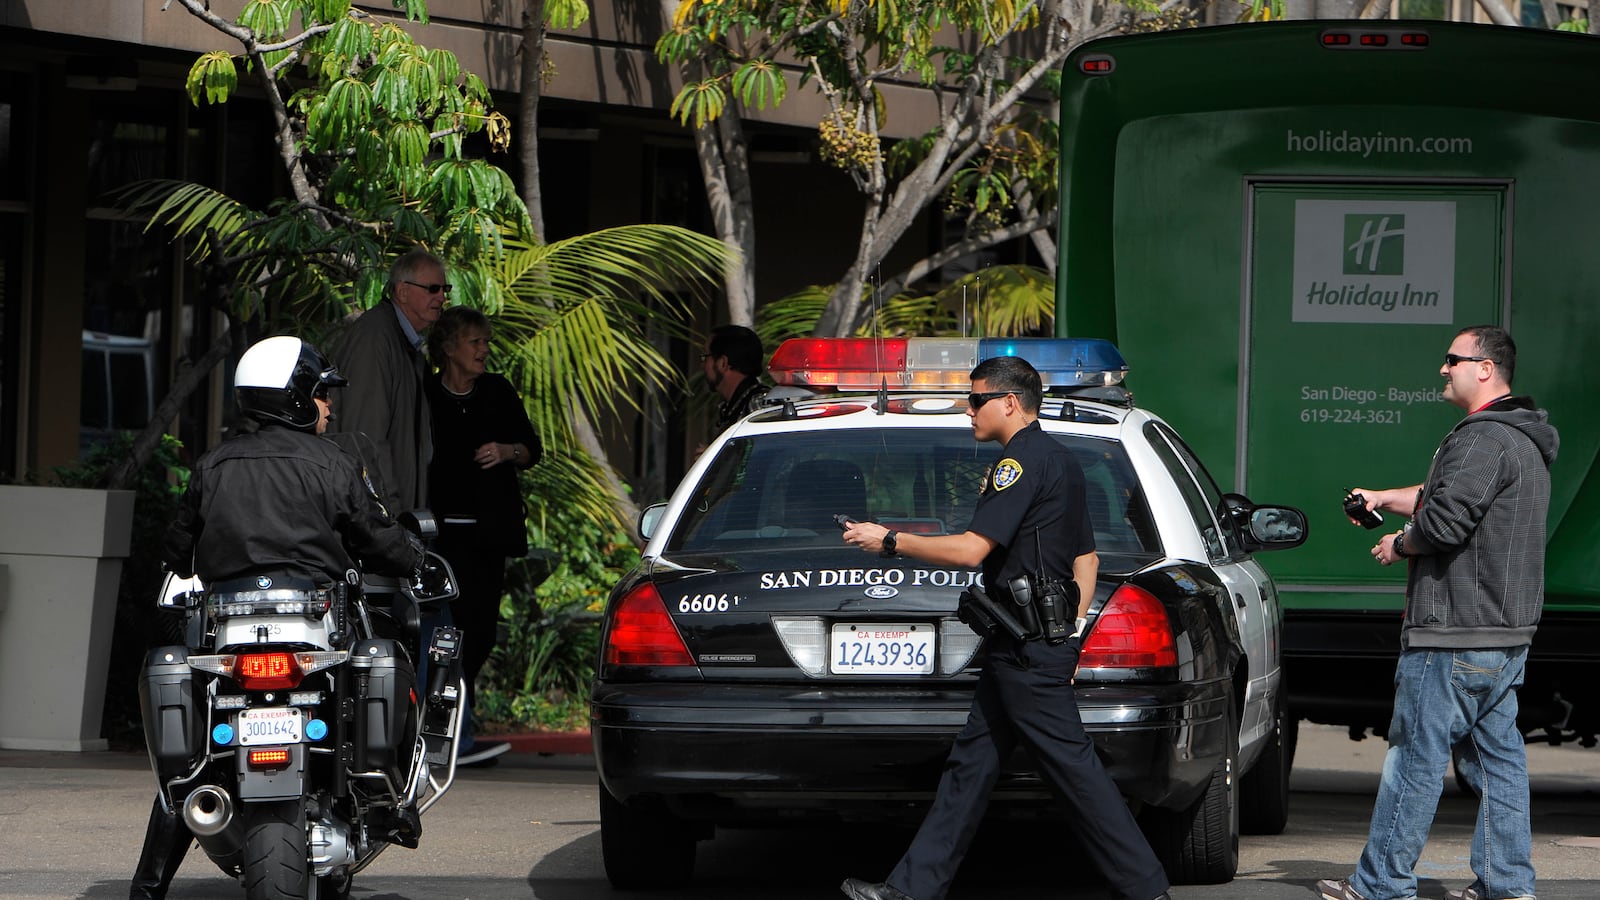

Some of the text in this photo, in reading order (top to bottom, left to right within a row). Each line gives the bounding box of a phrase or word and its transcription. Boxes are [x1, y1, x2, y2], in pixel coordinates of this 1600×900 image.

[1287, 129, 1473, 158] holidayinn.com
[1306, 281, 1440, 312] Holiday Inn
[1301, 386, 1329, 401] San
[1332, 386, 1377, 404] Diego
[1388, 387, 1445, 405] Bayside
[1300, 409, 1402, 424] 619-224-3621
[760, 568, 985, 589] SAN DIEGO POLIC
[678, 594, 729, 613] 6606
[250, 623, 282, 636] 425
[857, 631, 910, 639] CA EXEMPT
[838, 641, 928, 666] 1243936
[247, 711, 291, 720] CA EXEMPT
[246, 720, 295, 737] 3001642
